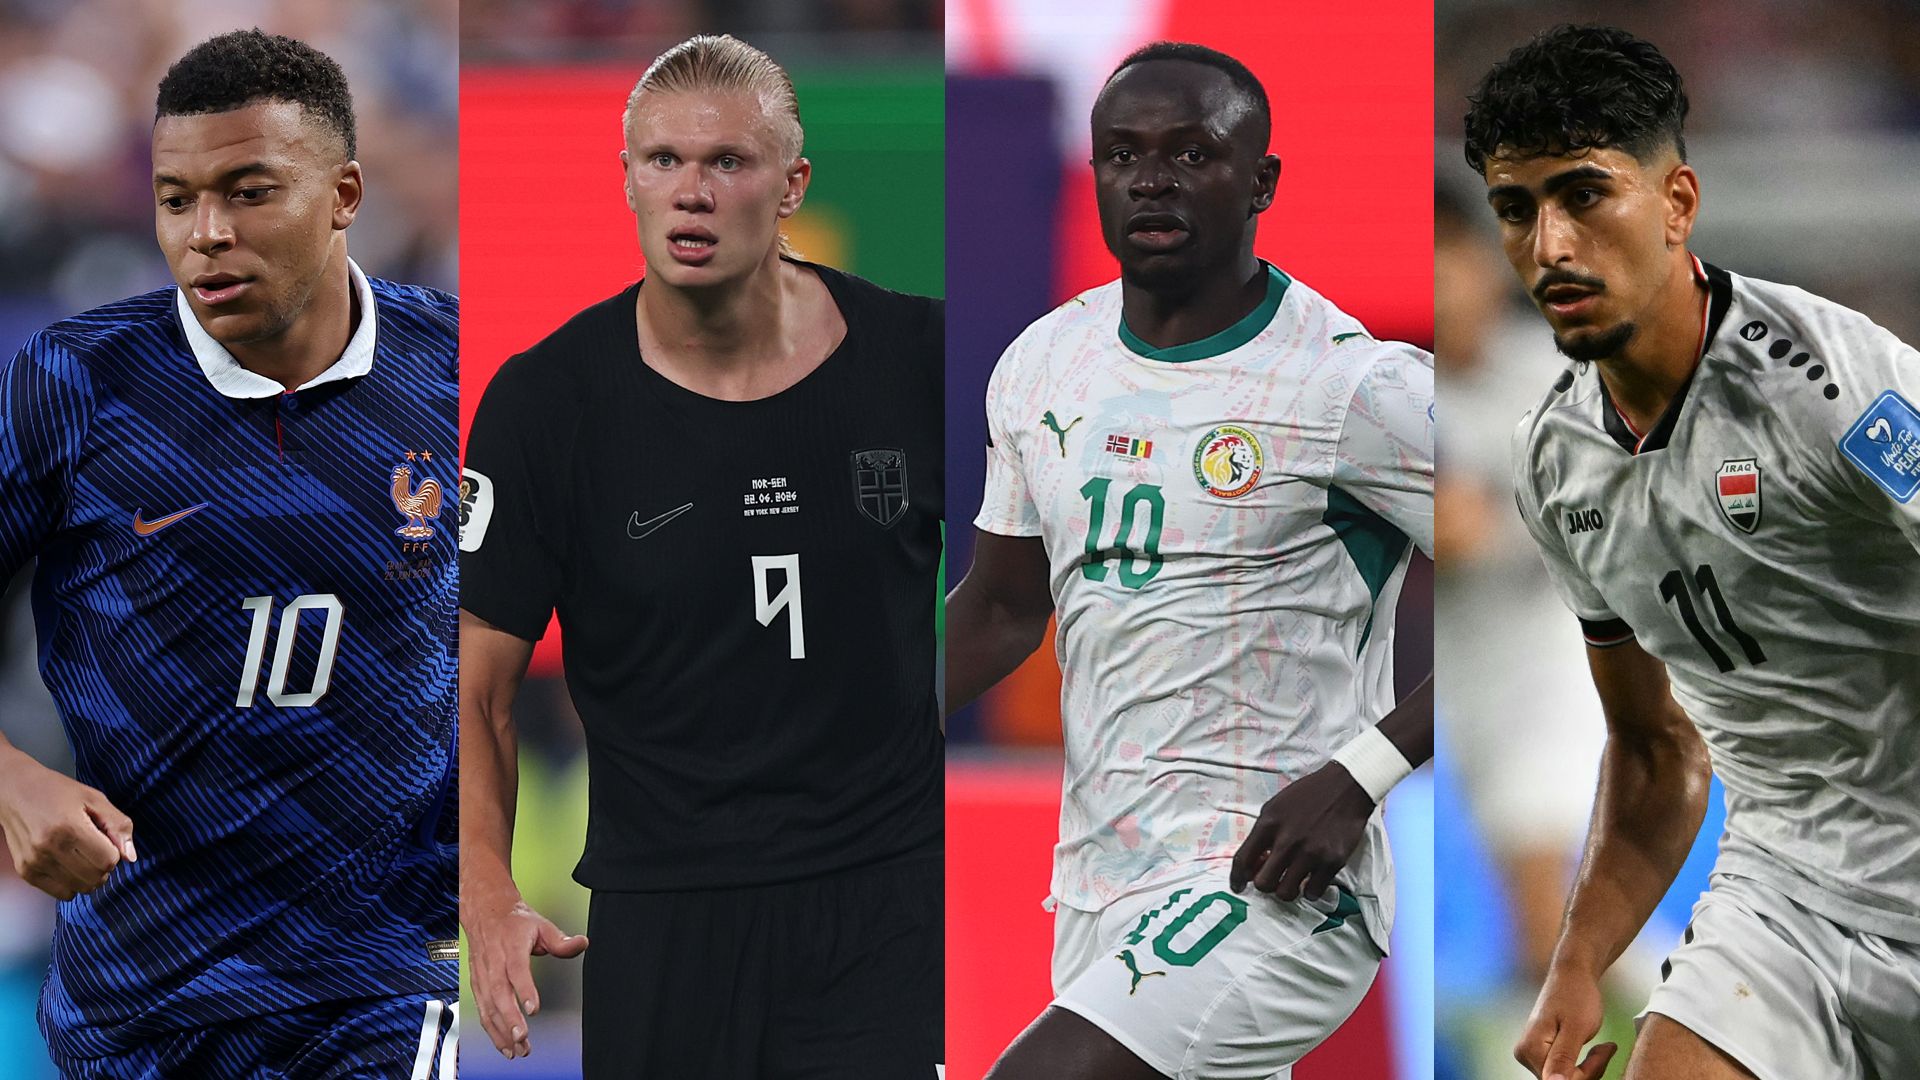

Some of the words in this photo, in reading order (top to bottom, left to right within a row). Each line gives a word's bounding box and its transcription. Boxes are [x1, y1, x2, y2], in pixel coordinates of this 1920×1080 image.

[1725, 463, 1751, 473] IRAQ
[1897, 429, 1913, 447] For
[744, 491, 798, 505] 22.06.2026
[752, 477, 787, 490] NOR-SEN
[1568, 508, 1604, 534] JAKO
[1080, 476, 1166, 590] 10
[751, 553, 805, 660] 9
[1659, 564, 1768, 674] 11
[236, 593, 345, 708] 10
[1123, 888, 1250, 967] 10
[410, 999, 459, 1080] 1
